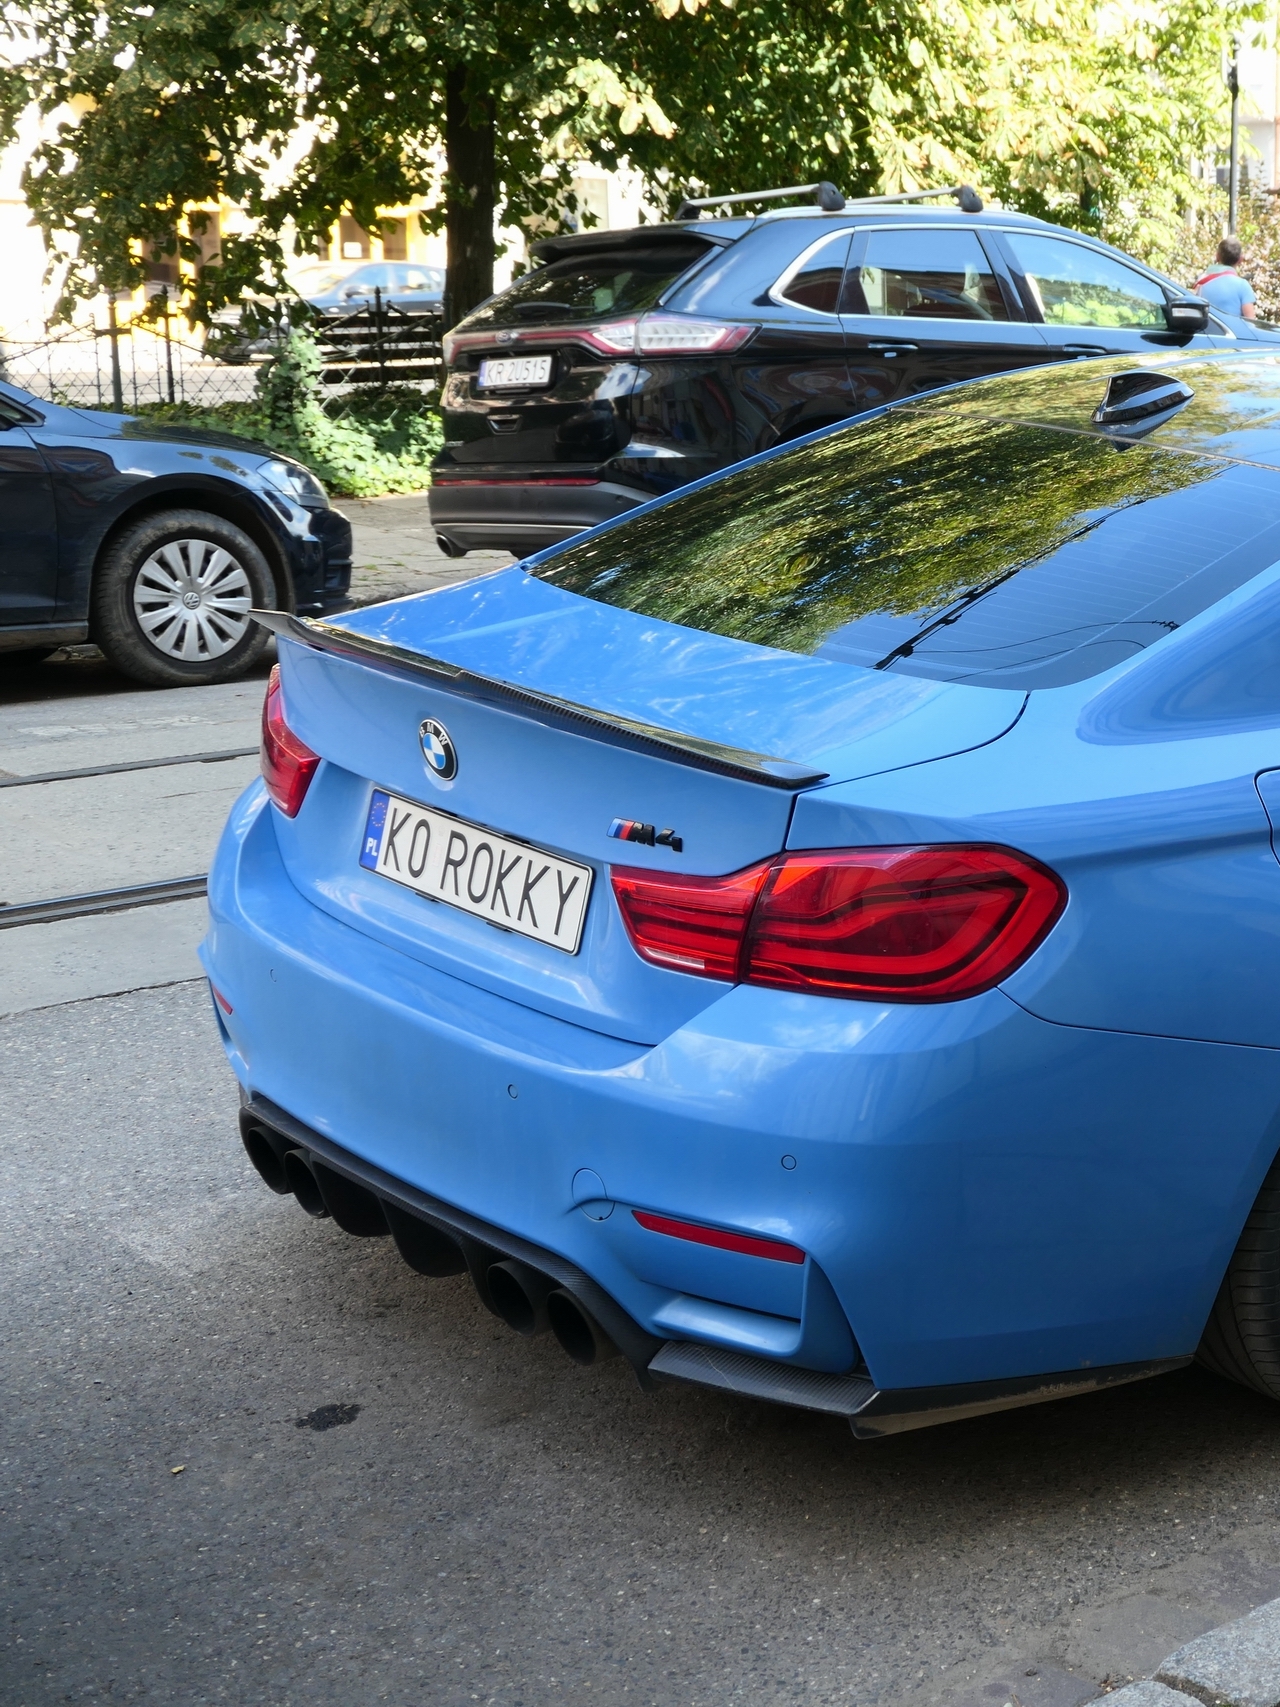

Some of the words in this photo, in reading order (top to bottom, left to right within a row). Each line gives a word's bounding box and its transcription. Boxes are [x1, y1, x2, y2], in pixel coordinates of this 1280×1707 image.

[486, 362, 505, 384] KR
[507, 359, 547, 382] 2U515
[419, 722, 448, 746] BMW
[365, 837, 378, 856] PL
[627, 821, 683, 853] M4
[439, 830, 580, 936] ROKKY
